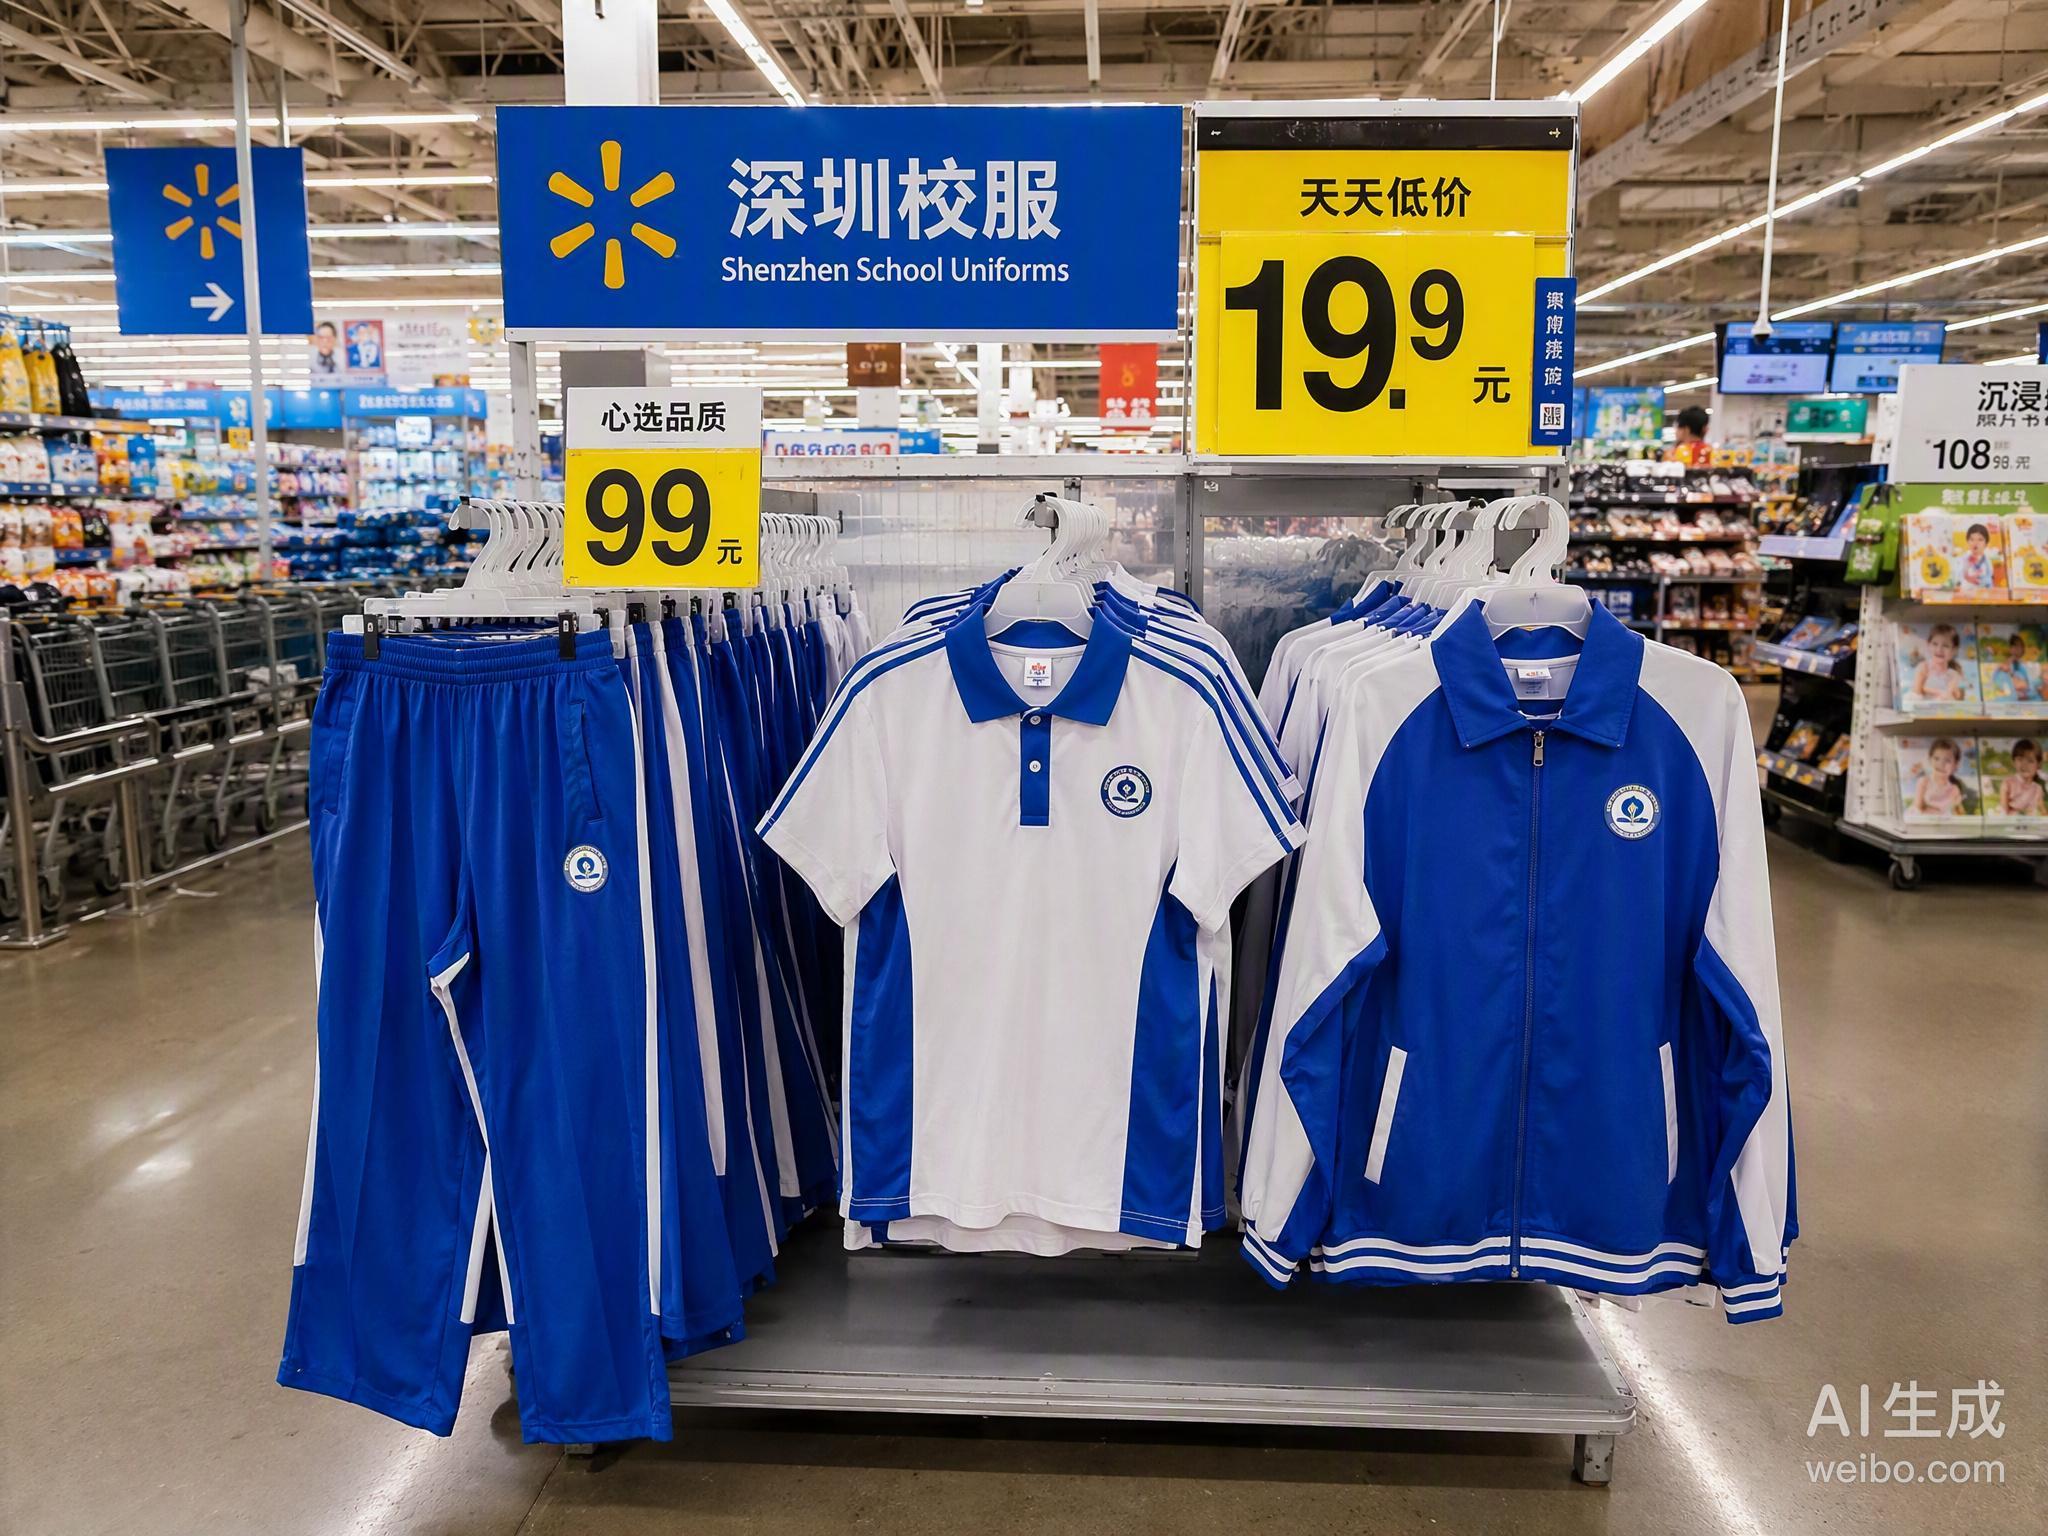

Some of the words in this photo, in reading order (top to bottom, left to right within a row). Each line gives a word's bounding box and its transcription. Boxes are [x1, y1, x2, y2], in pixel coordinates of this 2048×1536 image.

[727, 157, 1061, 240] 深圳校服
[1300, 177, 1471, 217] 天天低价
[722, 257, 849, 283] Shenzhen
[856, 257, 944, 283] School
[950, 257, 1070, 283] Uniforms
[1225, 256, 1464, 412] 19.9
[1473, 366, 1510, 404] 元
[1978, 381, 2048, 412] 沉浸
[601, 401, 727, 432] 心选品质
[1933, 439, 1991, 470] 108
[585, 468, 711, 567] 99
[717, 539, 742, 565] 元
